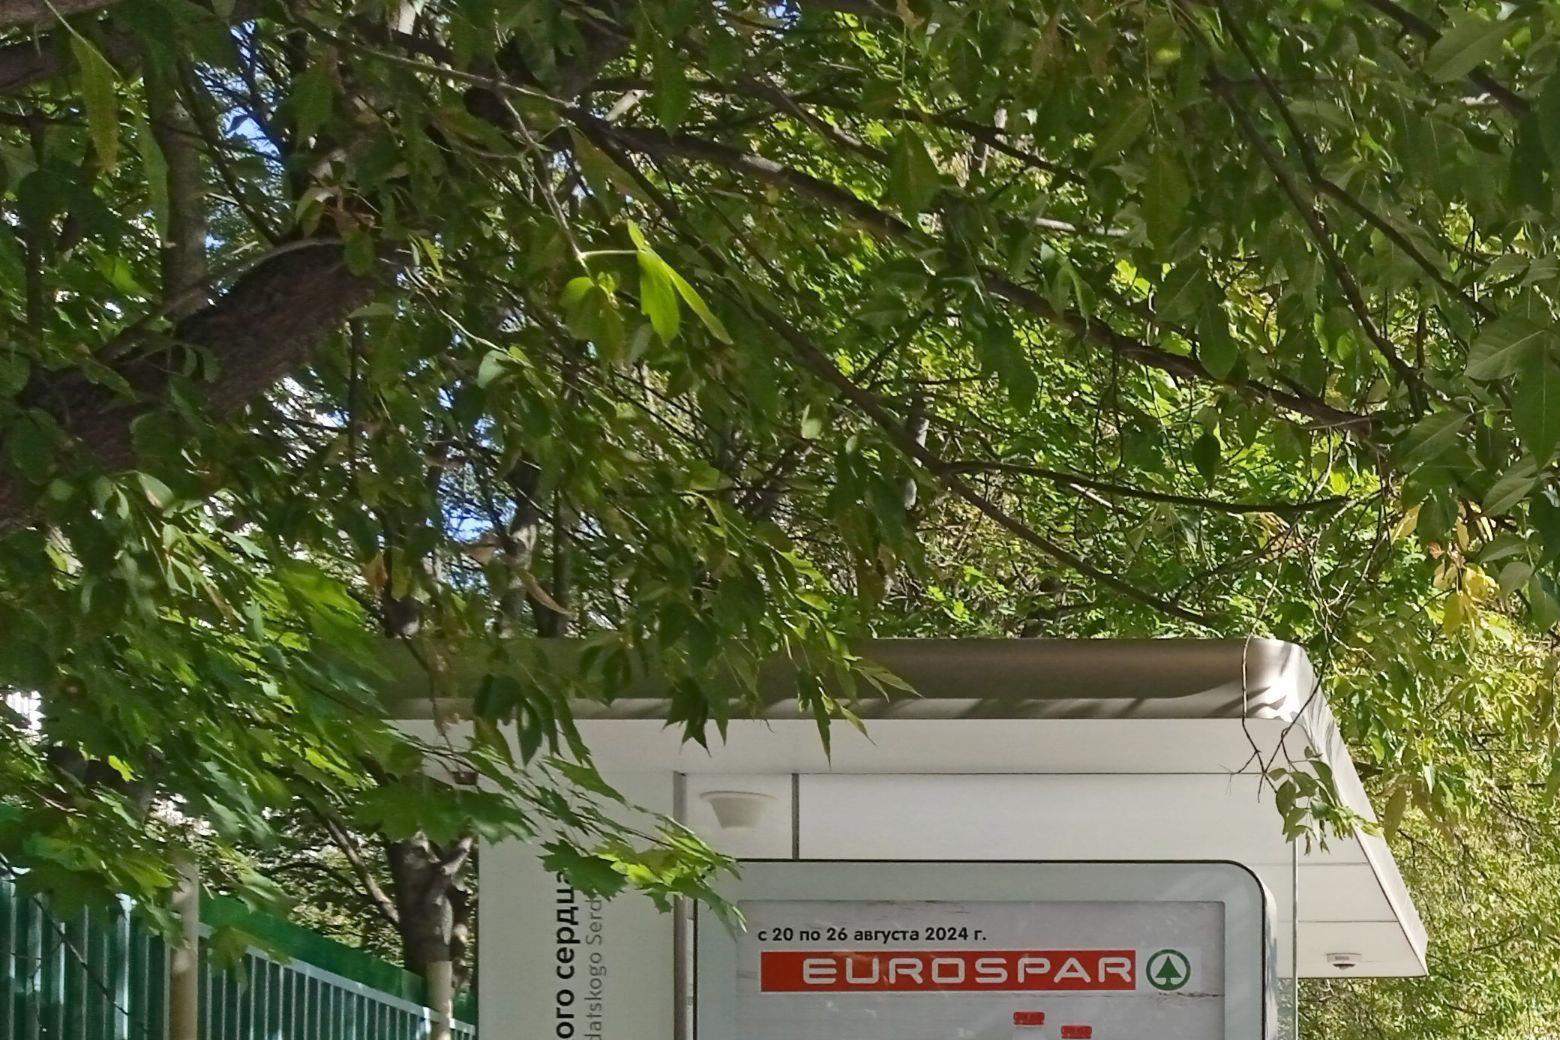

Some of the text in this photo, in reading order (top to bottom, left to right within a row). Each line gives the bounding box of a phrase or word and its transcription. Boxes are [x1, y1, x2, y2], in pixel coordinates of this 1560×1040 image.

[585, 899, 602, 945] Serd
[758, 927, 987, 944] с 20 по 26 августа 2024 г.
[802, 957, 1132, 984] EUROSPAR
